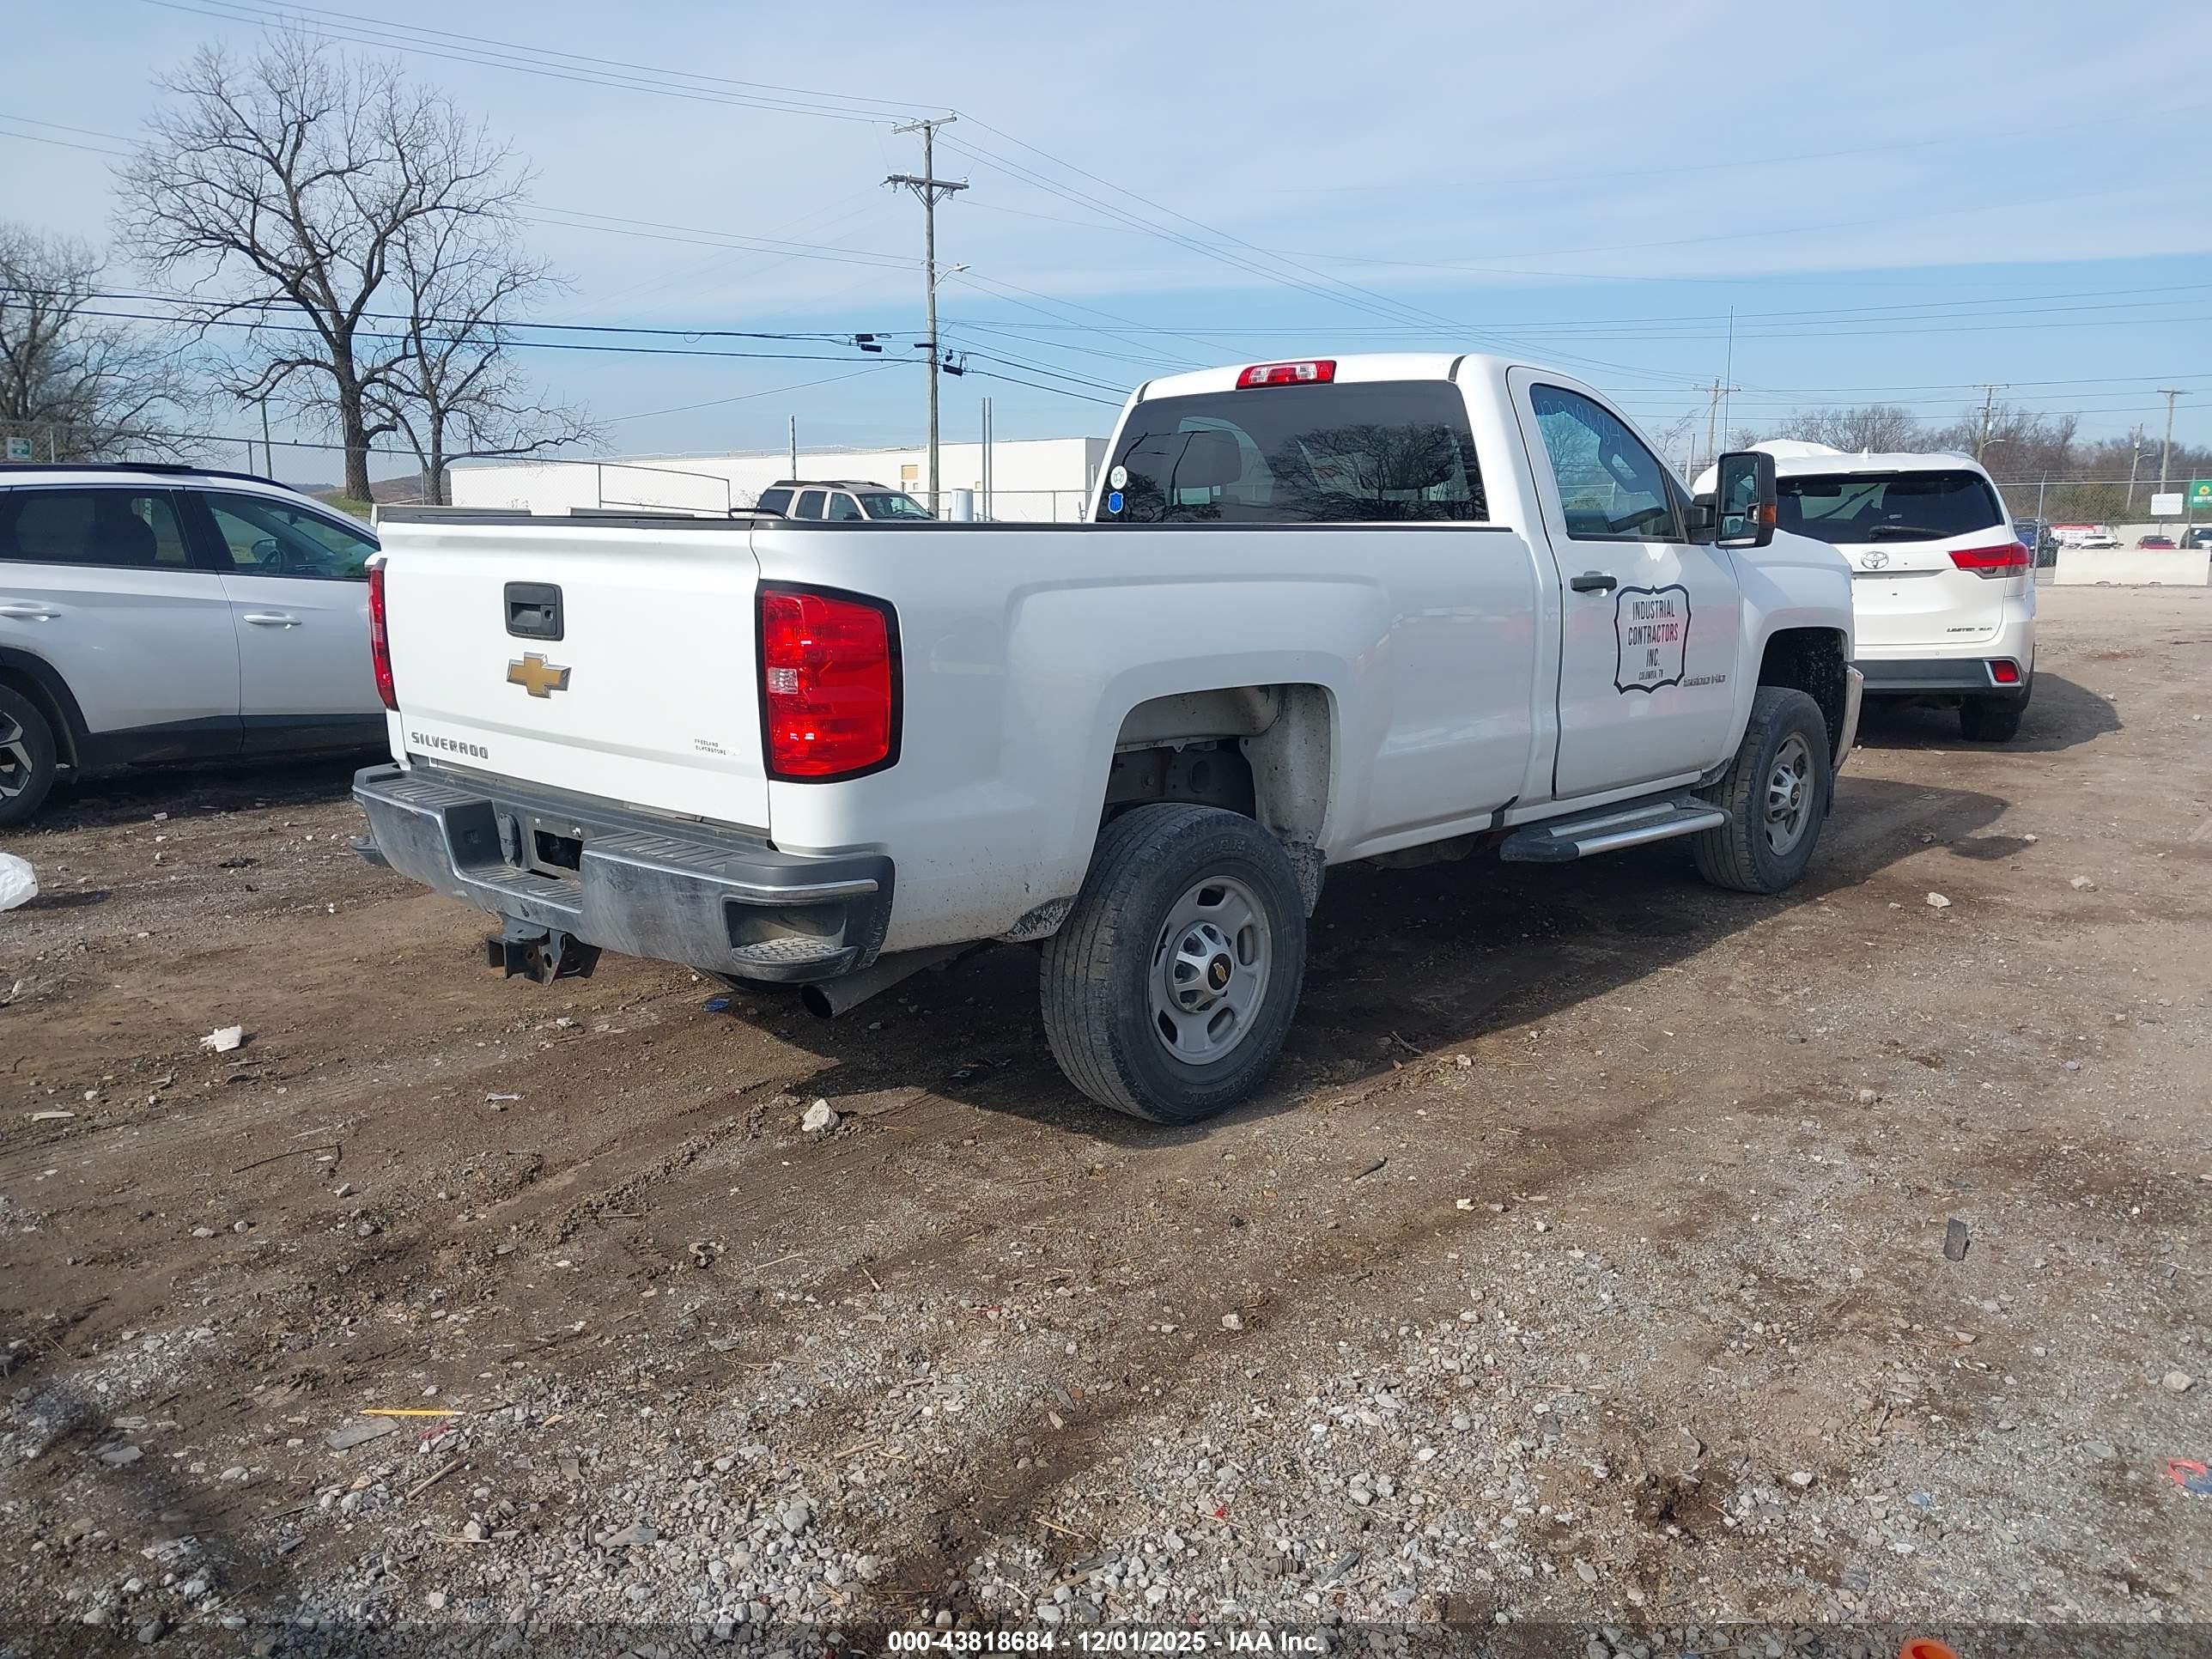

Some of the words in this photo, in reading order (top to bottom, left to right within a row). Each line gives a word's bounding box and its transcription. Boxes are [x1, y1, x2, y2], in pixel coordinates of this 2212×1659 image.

[1632, 599, 1675, 622] INDUSTRIAL
[1628, 623, 1679, 646] CONTRACTORS
[1646, 647, 1661, 668] INC.
[411, 732, 489, 760] SILVERADO
